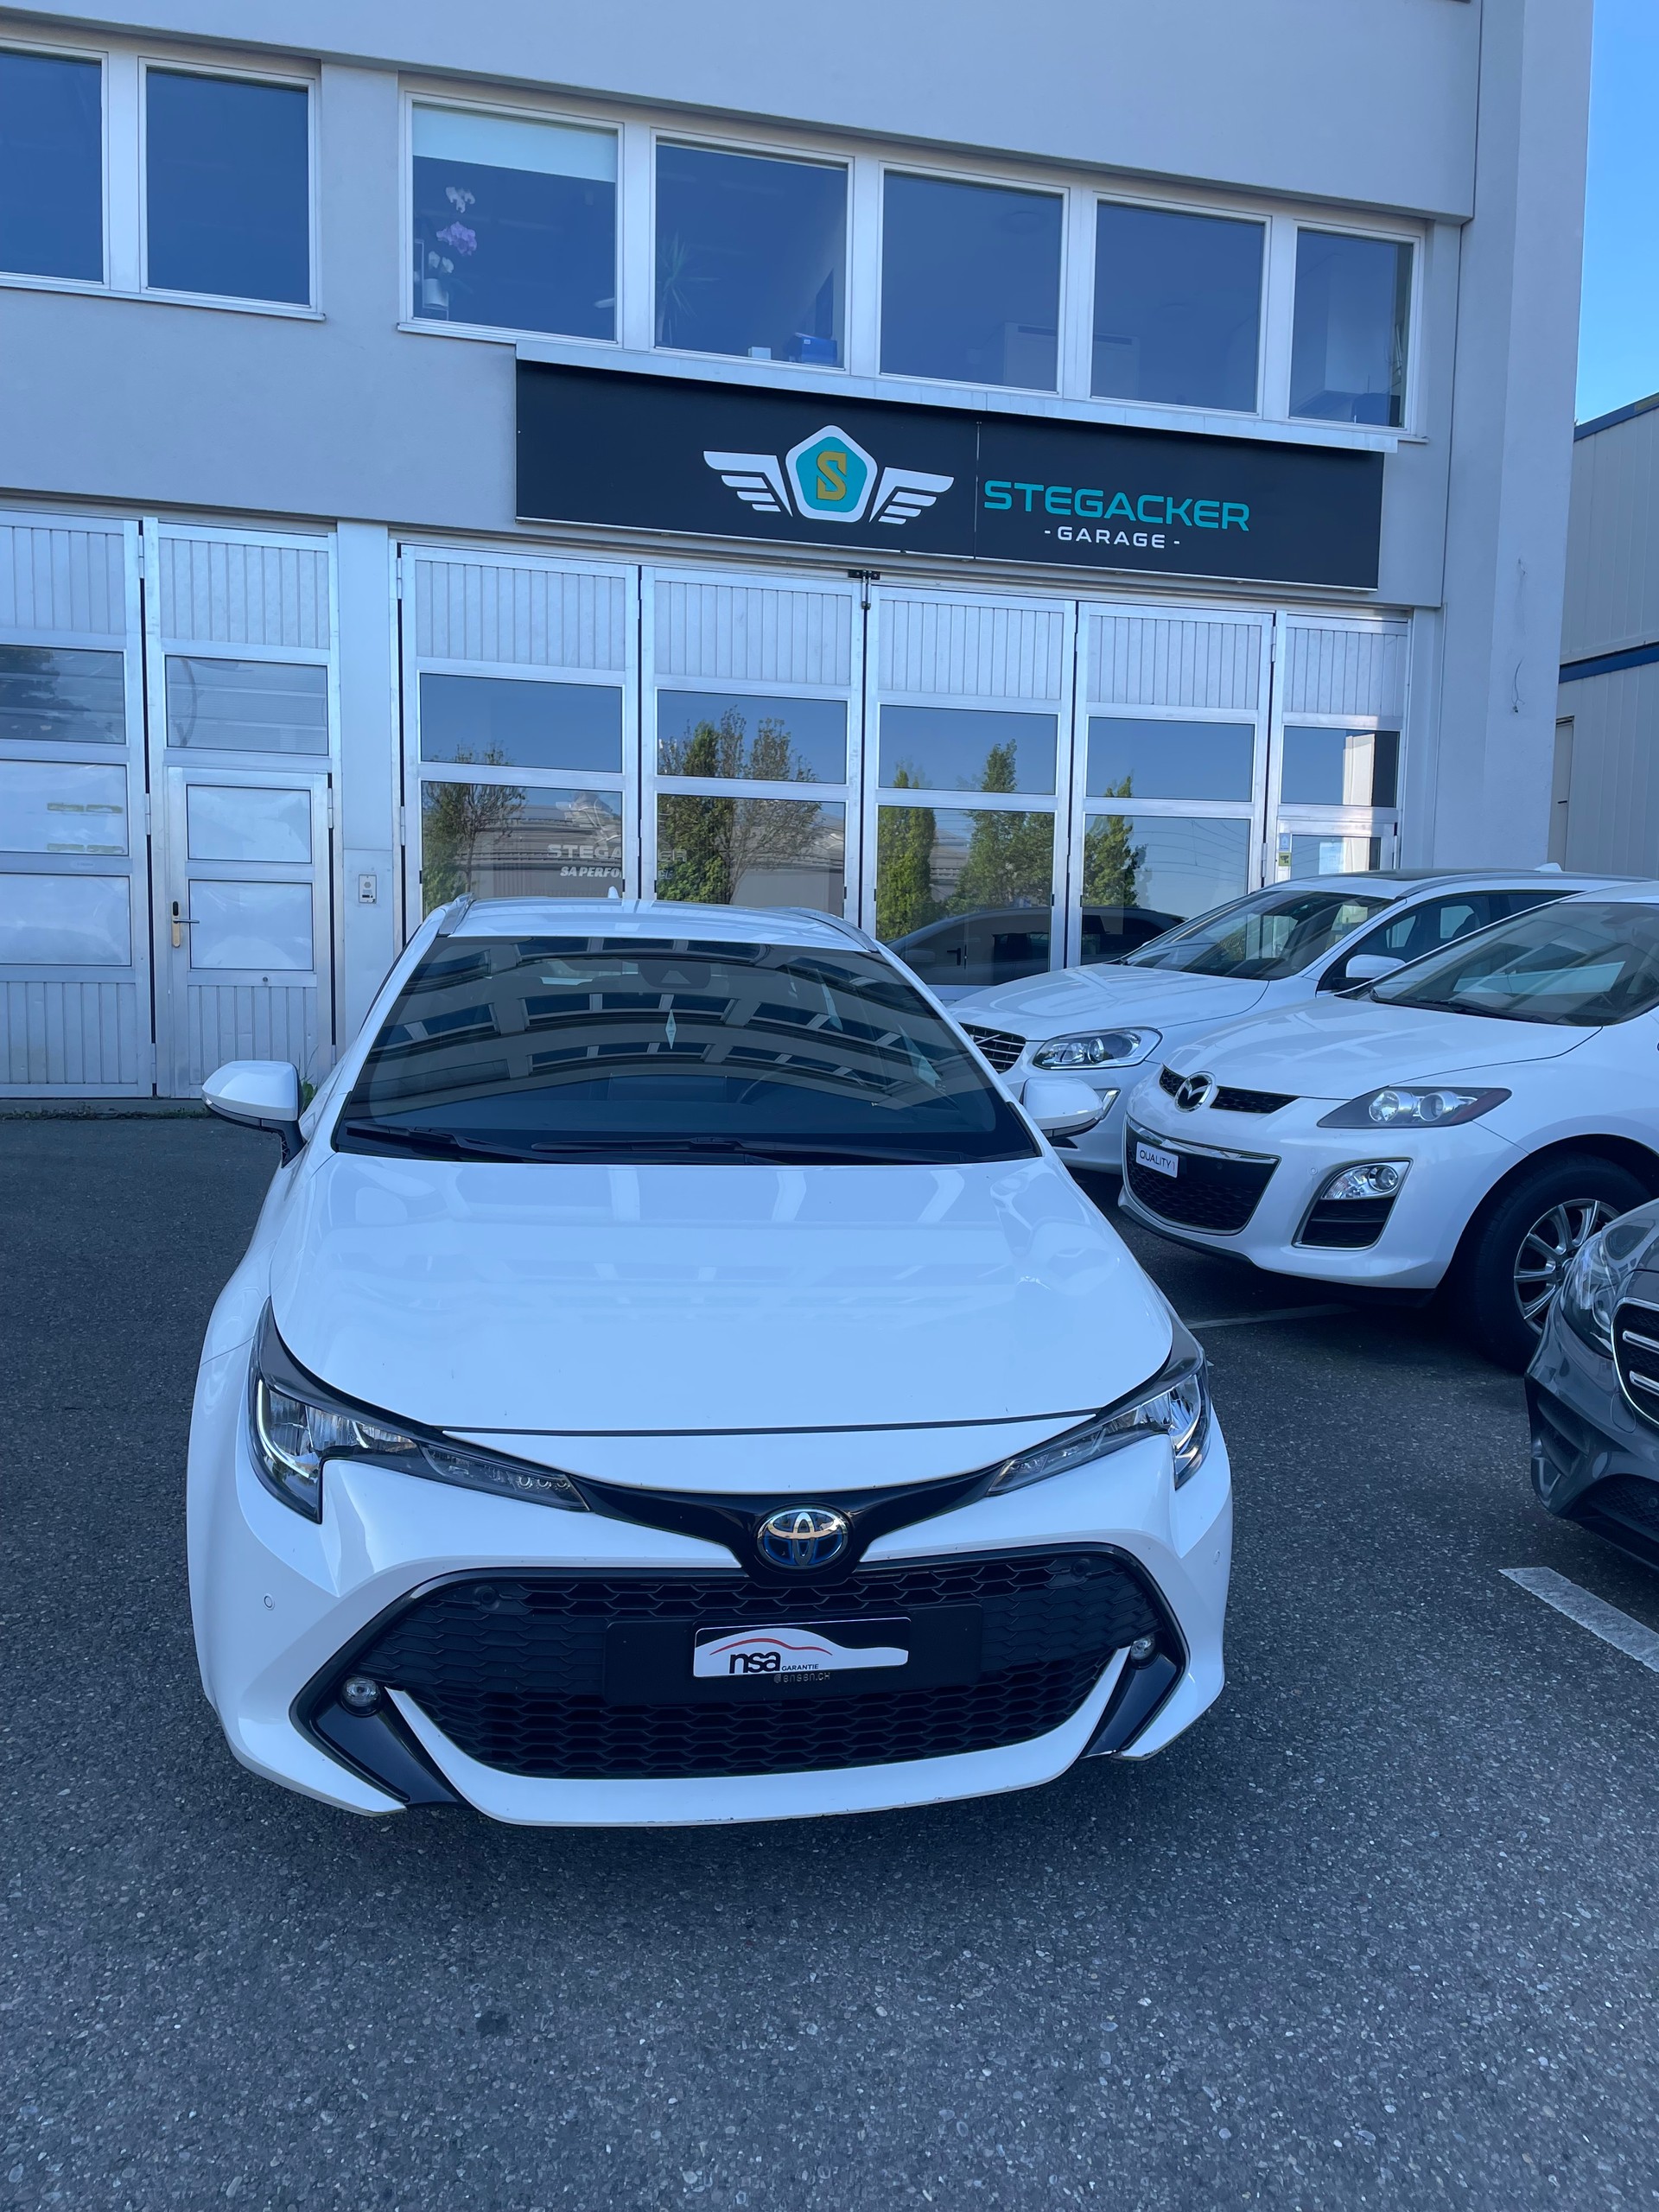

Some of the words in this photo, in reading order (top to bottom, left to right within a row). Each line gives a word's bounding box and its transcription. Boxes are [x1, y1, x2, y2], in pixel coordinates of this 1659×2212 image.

[816, 451, 847, 501] S
[984, 480, 1250, 531] STEGACKER
[728, 1651, 781, 1675] nsa
[781, 1663, 820, 1672] GARANTIE
